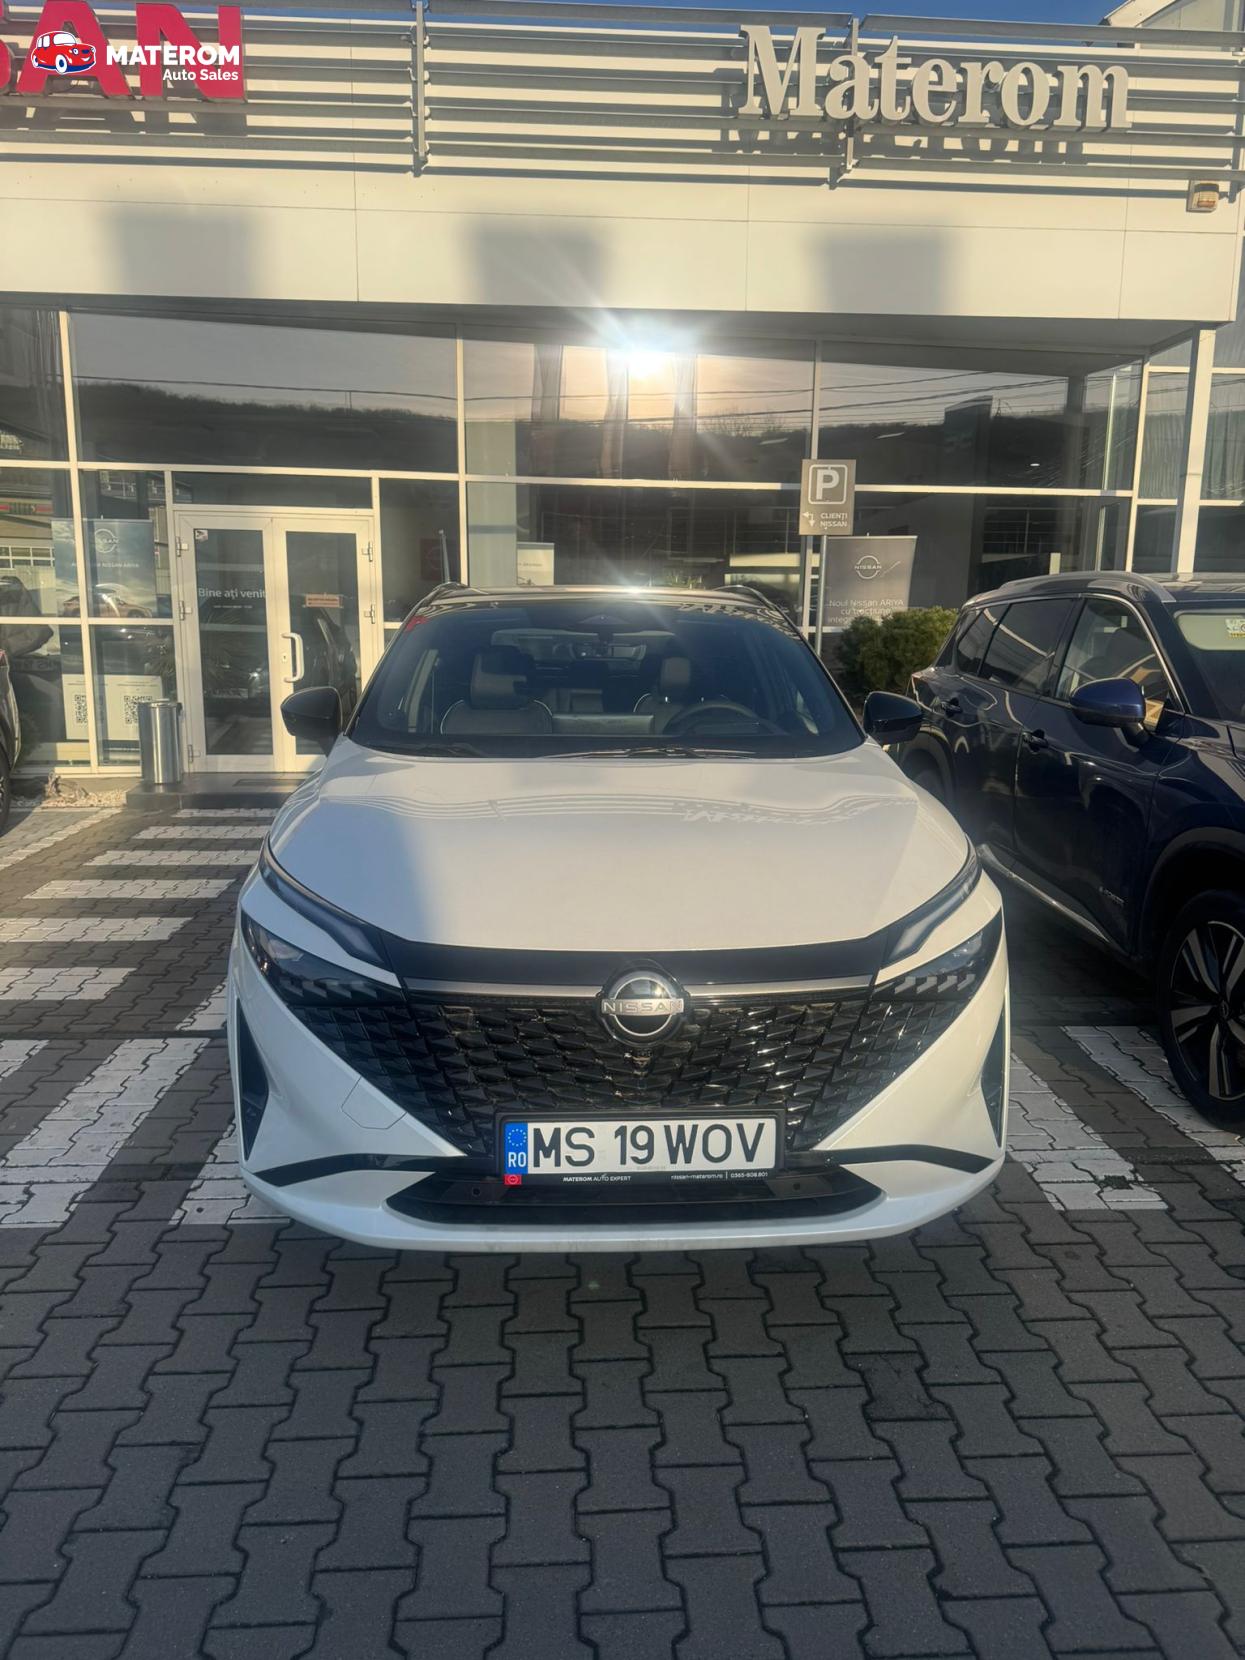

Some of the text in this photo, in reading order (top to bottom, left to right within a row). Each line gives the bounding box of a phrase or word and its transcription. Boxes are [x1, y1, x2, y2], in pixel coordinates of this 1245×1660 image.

[0, 0, 245, 99] AN
[738, 24, 1131, 129] Materom
[815, 469, 840, 500] P
[198, 587, 222, 598] Bine
[240, 588, 267, 599] venit
[850, 599, 879, 608] Nissan
[880, 599, 905, 608] ARIYA
[603, 1002, 683, 1013] NISSAN
[508, 1122, 766, 1168] RO MS 19 WOV
